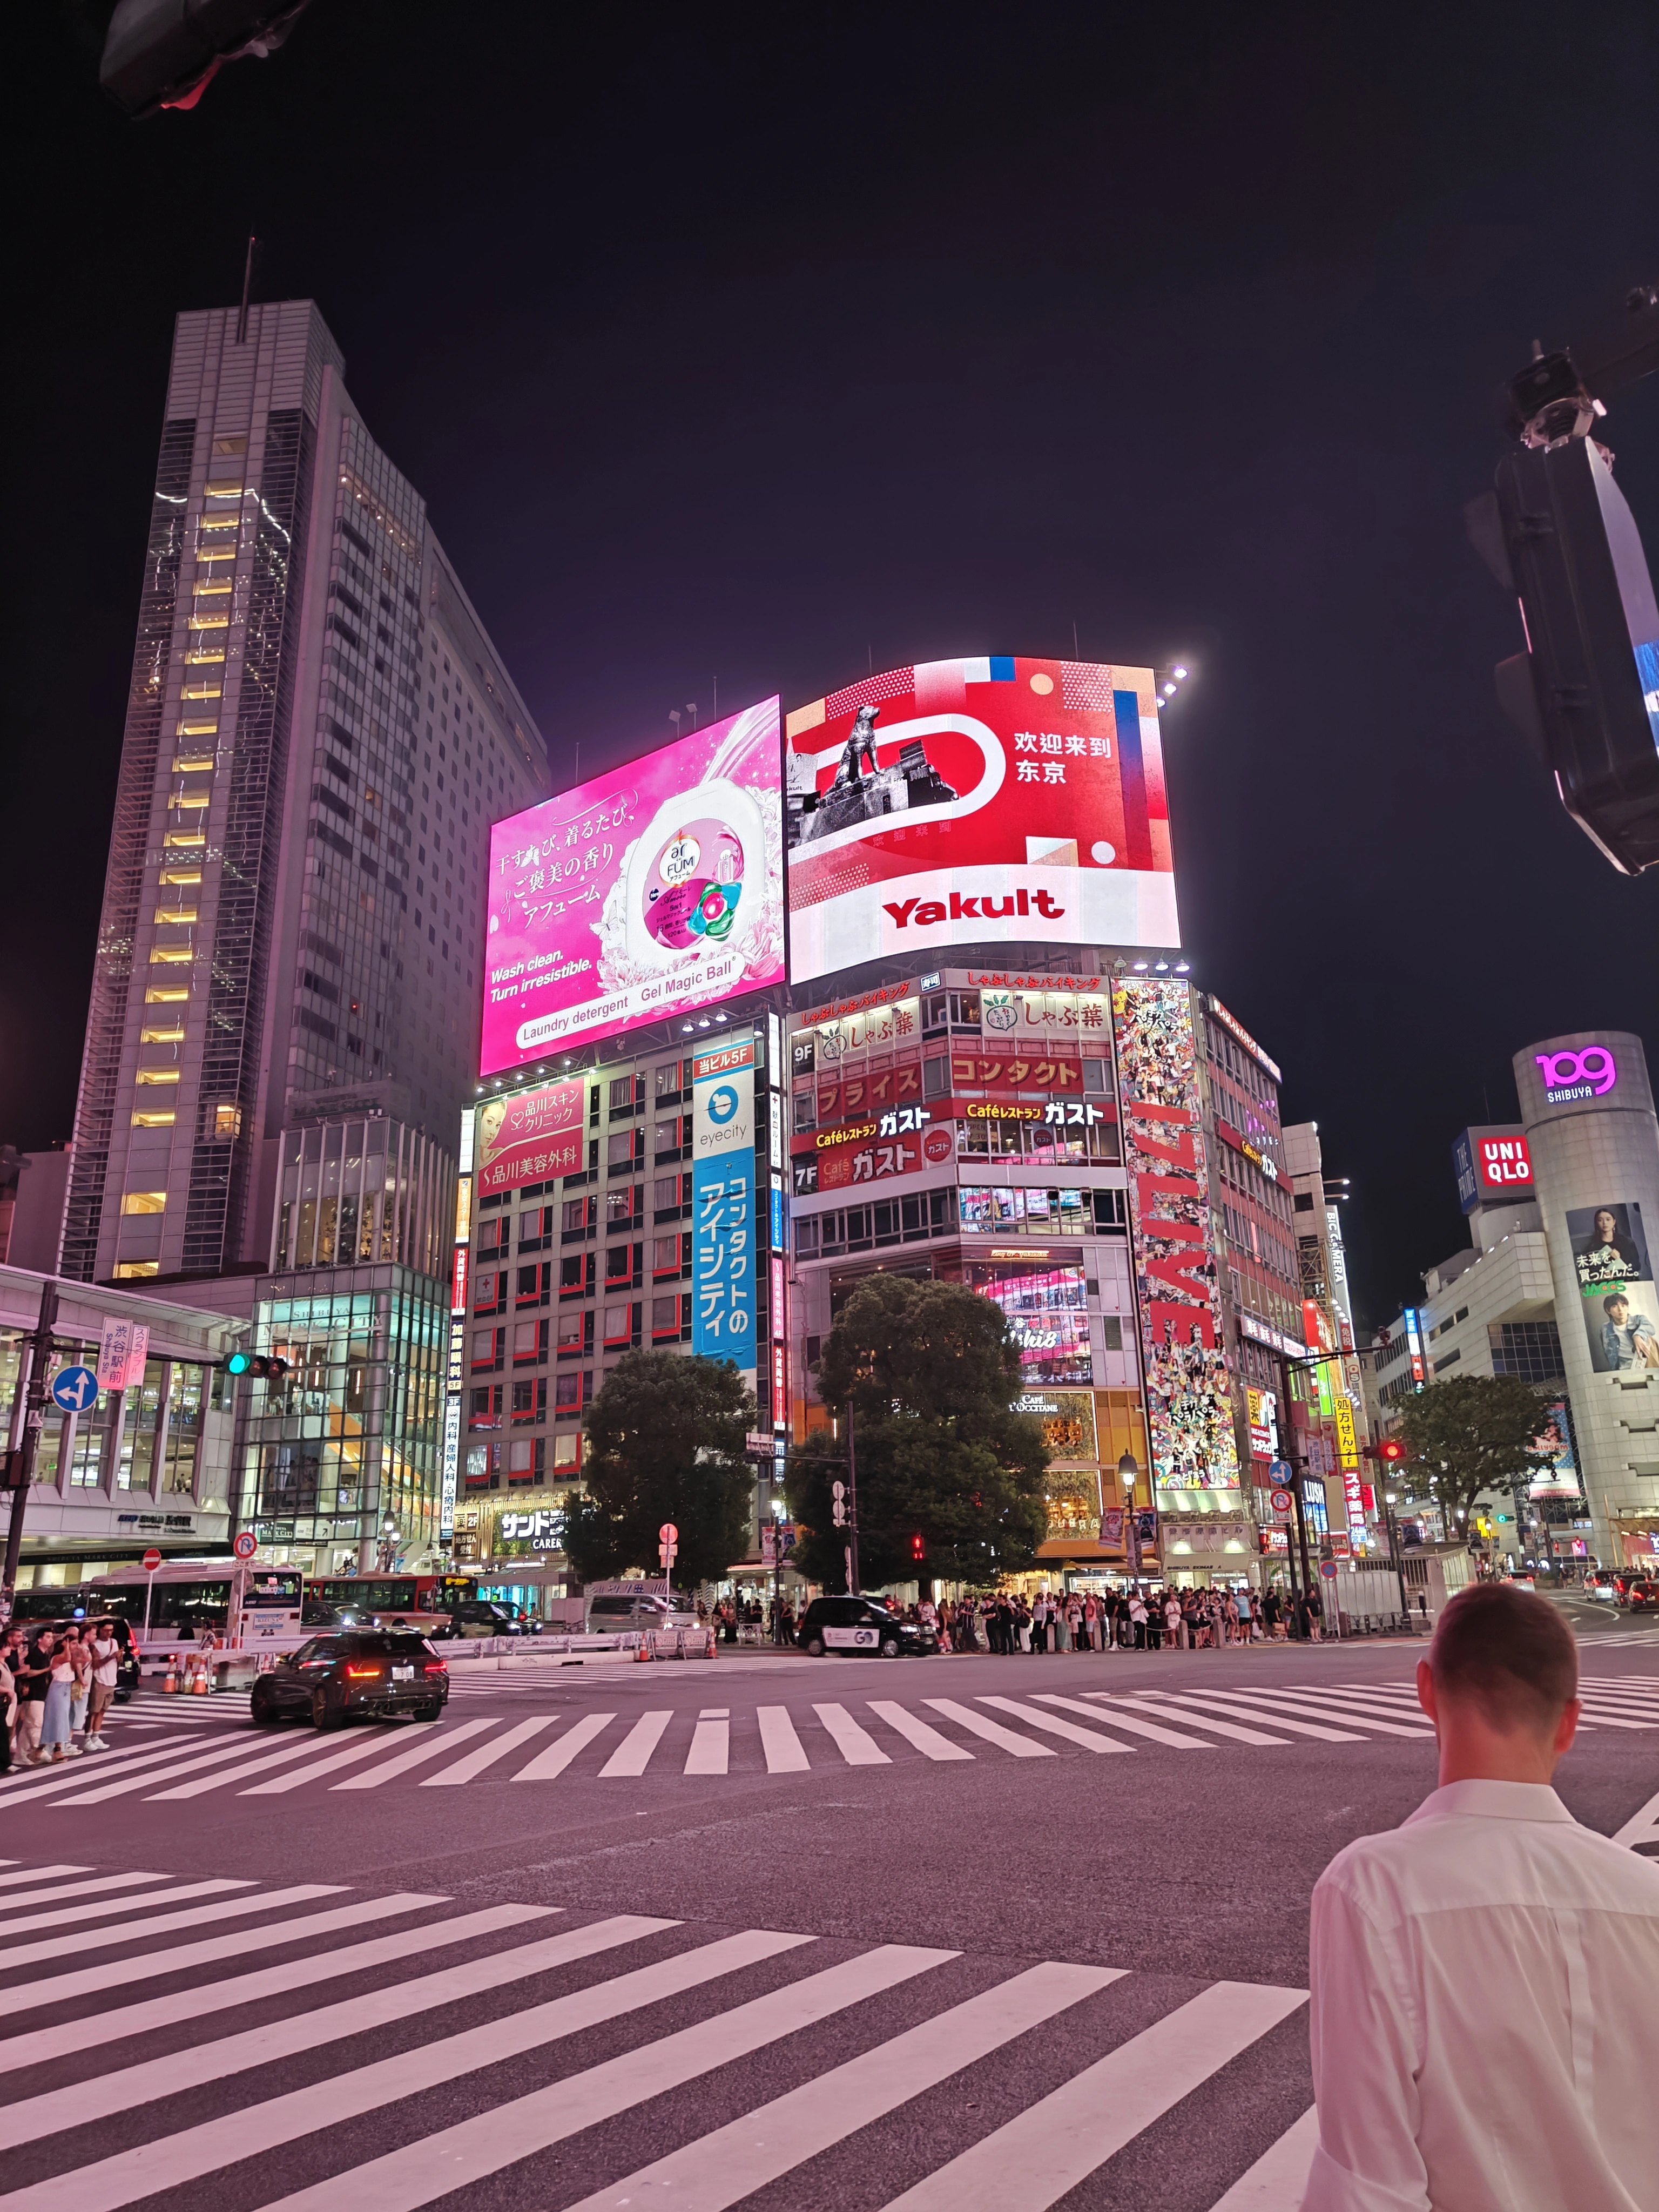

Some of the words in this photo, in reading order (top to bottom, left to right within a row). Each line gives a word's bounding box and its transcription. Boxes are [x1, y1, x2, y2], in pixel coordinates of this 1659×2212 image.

[1014, 731, 1111, 758] 欢迎来到
[1016, 759, 1067, 784] 东京
[514, 842, 613, 899] ご褒美の香り
[669, 871, 690, 882] アフューム
[524, 884, 601, 929] アフューム
[656, 907, 691, 923] ジェルマジックール
[881, 888, 1065, 929] Yakult
[491, 962, 524, 984] Wash
[527, 948, 564, 970] clean.
[490, 983, 518, 1003] Turn
[521, 958, 592, 996] irresistible.
[641, 981, 661, 1002] Gel
[665, 973, 703, 995] Magic
[923, 976, 939, 988] 寿司
[968, 972, 1101, 991] しゃぶしゃぶバイキング
[801, 981, 910, 1025] しゃぶしゃぶバイキング
[1026, 1002, 1103, 1028] しゃぶ葉
[523, 1015, 569, 1041] Laundry
[572, 996, 629, 1028] detergent
[852, 1011, 914, 1048] しゃぶ葉
[699, 1048, 747, 1075] 当ビル5F
[795, 1044, 813, 1062] 9F
[953, 1060, 1078, 1086] コンタクト
[1536, 1047, 1616, 1095] 109
[525, 1089, 579, 1115] 品川スキン
[819, 1066, 920, 1113] プライス
[1548, 1085, 1593, 1103] SHIBUYA
[525, 1108, 572, 1133] クリニック
[880, 1107, 930, 1137] ガスト
[1045, 1102, 1104, 1125] ガスト
[700, 1125, 747, 1148] eyecity
[928, 1143, 949, 1155] ガスト
[853, 1144, 915, 1182] ガスト
[1457, 1143, 1468, 1172] THE
[1485, 1142, 1523, 1161] UNI
[492, 1145, 577, 1185] 品川美容外科
[795, 1165, 817, 1186] 7F
[824, 1158, 849, 1176] Café
[1488, 1161, 1529, 1183] QLO
[1458, 1167, 1476, 1204] PRIME
[1327, 1212, 1337, 1231] BIC
[699, 1182, 725, 1337] アイシティ
[729, 1177, 748, 1334] コンタクトの
[1576, 1251, 1616, 1268] 未来を、
[1579, 1264, 1640, 1283] 買ったんだ。
[1582, 1280, 1626, 1297] JACCS
[264, 1320, 325, 1336] MARK
[334, 1314, 385, 1330] CITY
[293, 1307, 350, 1319] SHIBUYA
[103, 1333, 113, 1360] Shibuya
[1341, 1327, 1352, 1346] 免税
[109, 1325, 128, 1384] 渋谷駅前
[131, 1328, 145, 1380] スクランブル
[449, 1323, 464, 1379] 加藤眼科
[449, 1381, 461, 1390] 5F
[1249, 1393, 1259, 1422] 薬
[447, 1422, 457, 1440] 内科
[1337, 1400, 1353, 1447] 処方せん
[1360, 1435, 1370, 1474] 処方受付
[1304, 1480, 1325, 1505] LUSH
[1345, 1473, 1365, 1525] スギ薬局
[457, 1513, 466, 1529] 薬
[468, 1516, 478, 1527] 2F
[455, 1534, 477, 1545] 処方せん
[460, 1545, 472, 1554] 受付
